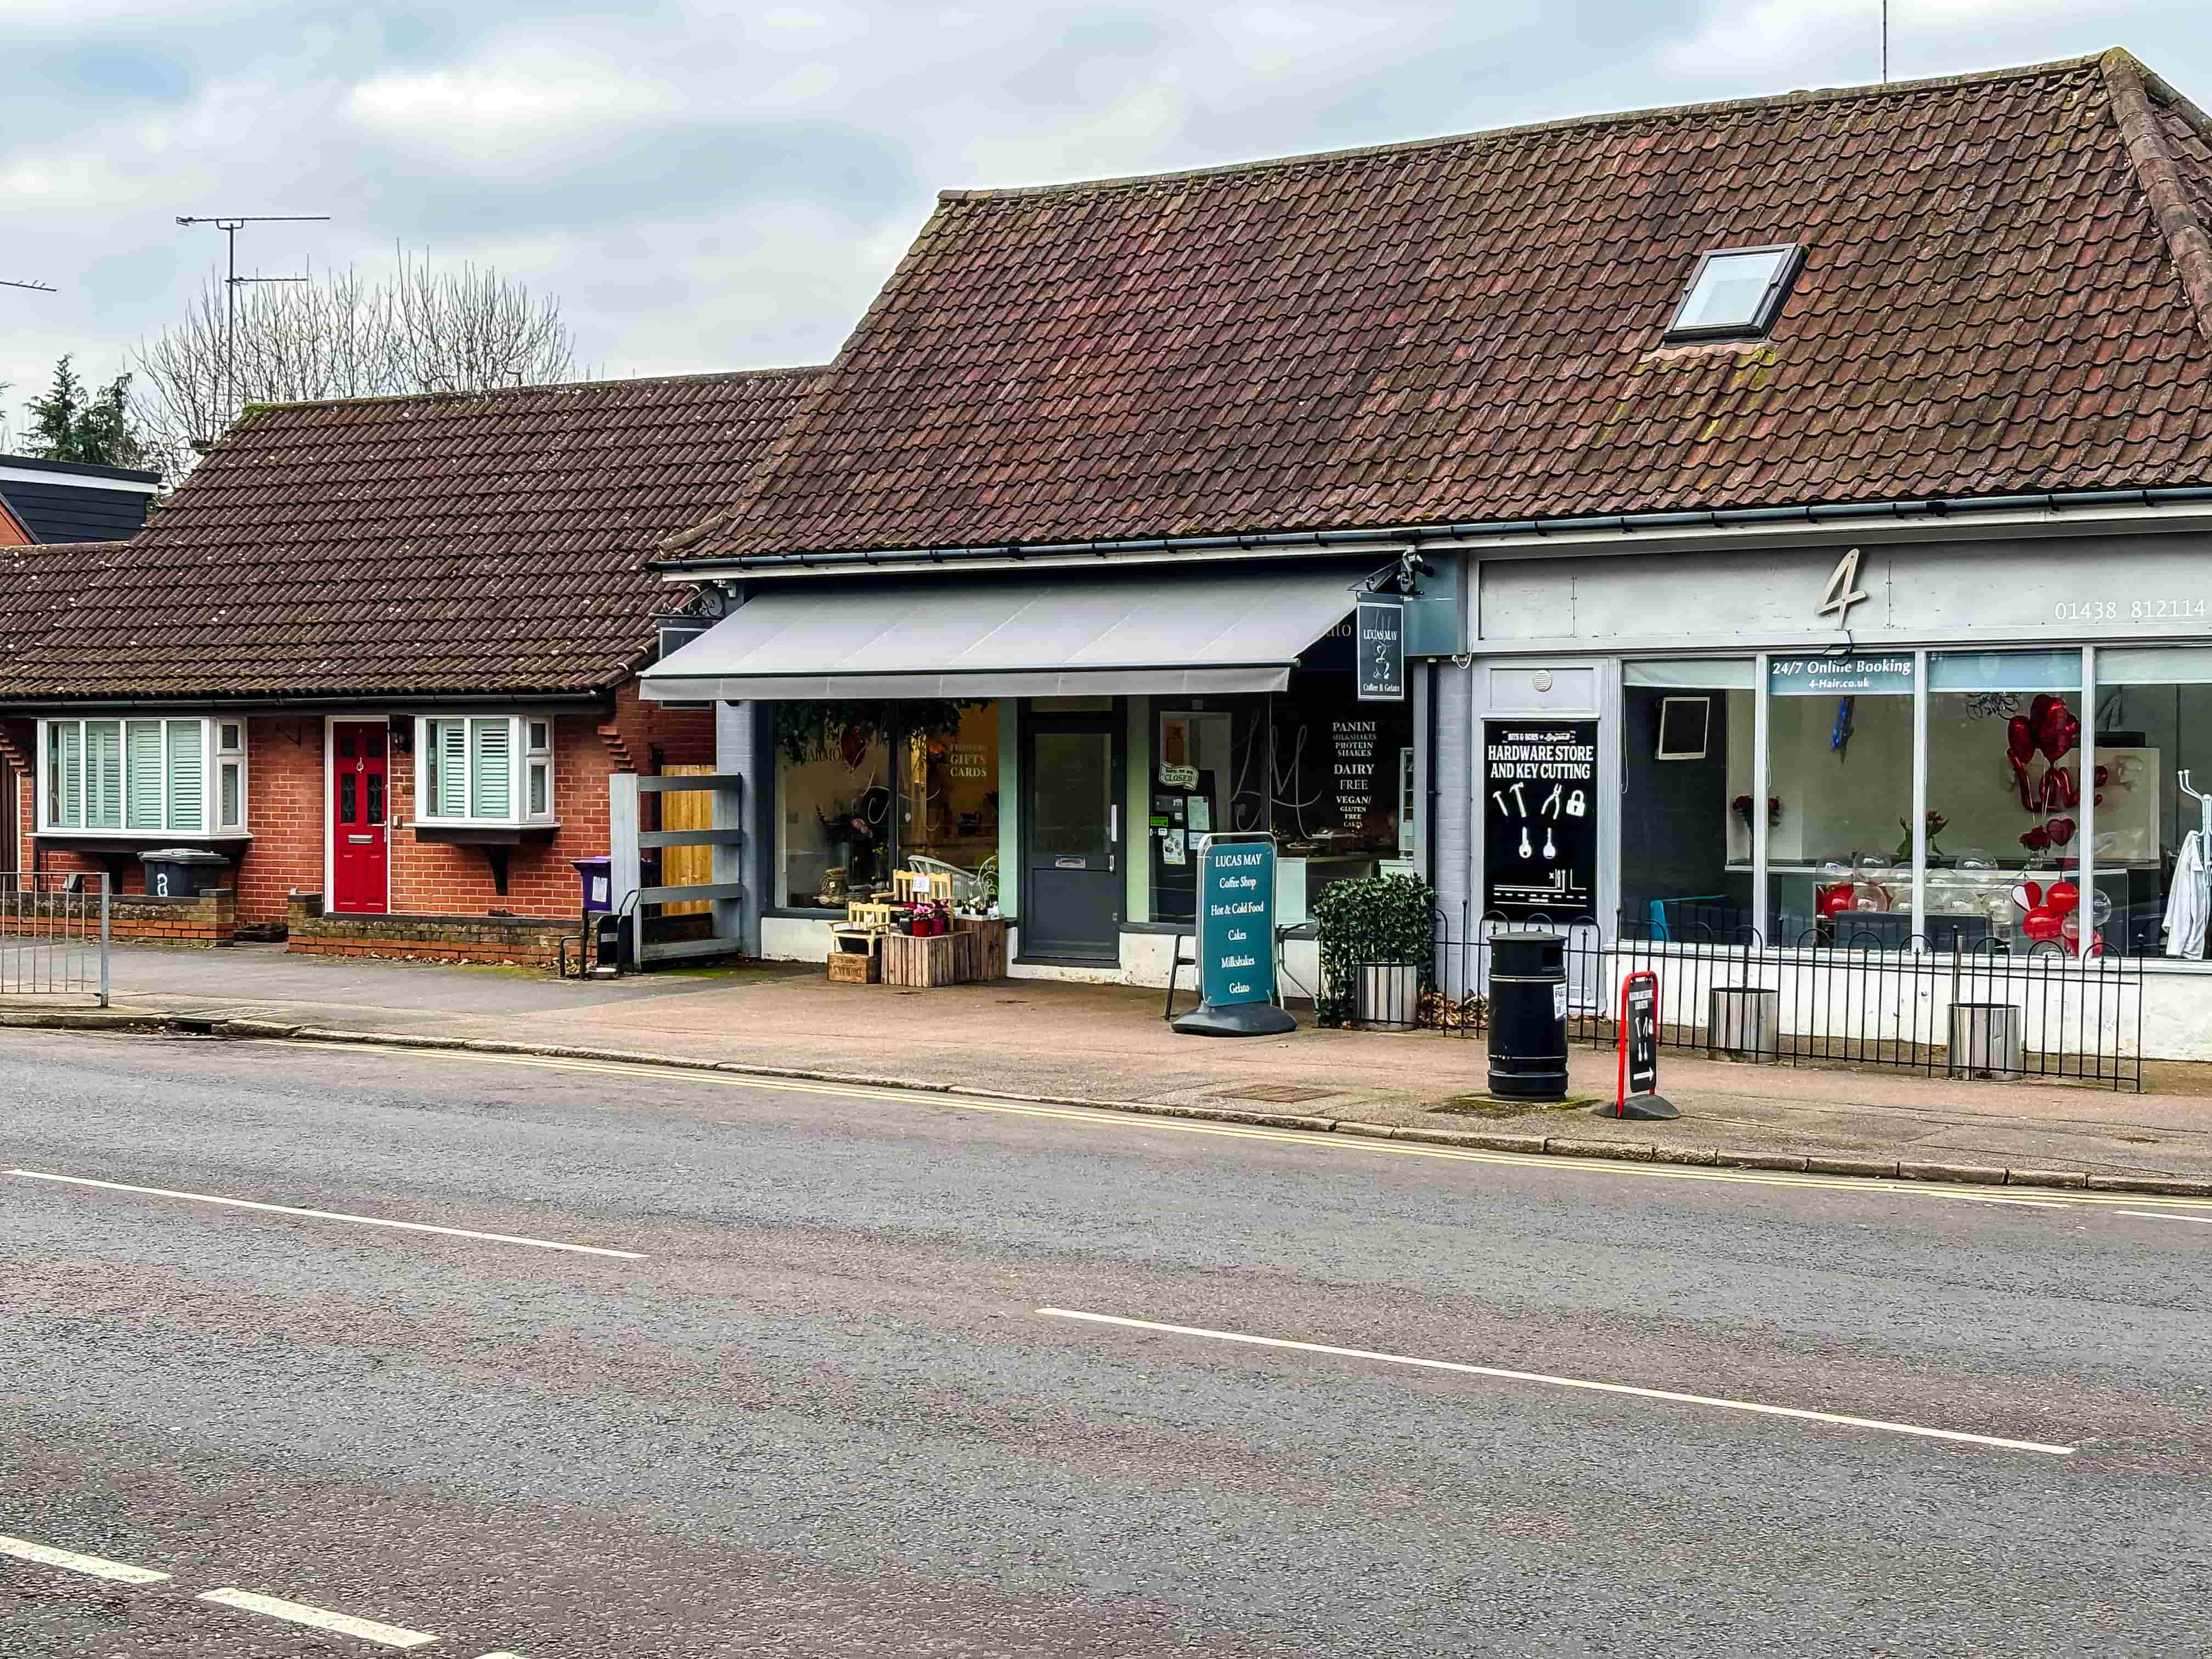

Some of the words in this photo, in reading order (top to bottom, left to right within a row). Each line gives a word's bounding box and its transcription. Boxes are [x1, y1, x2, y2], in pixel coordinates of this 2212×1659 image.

[1816, 548, 1870, 629] 4
[2055, 601, 2117, 620] 01438
[2131, 599, 2206, 618] 812114
[1773, 662, 1803, 676] 24/7
[1807, 661, 1852, 674] Online
[1857, 658, 1911, 675] Booking
[1809, 677, 1870, 688] 4-Hair.co.uk
[1332, 721, 1376, 732] PANINI
[951, 754, 986, 764] GIFTS
[1488, 746, 1554, 761] HARDWARE
[1555, 746, 1594, 761] STORE
[950, 768, 987, 777] CARDS
[1334, 764, 1374, 775] DAIRY
[1491, 763, 1515, 778] AND
[1516, 763, 1538, 778] KEY
[1540, 763, 1590, 779] CUTTING
[1164, 774, 1193, 782] CLOSED
[1340, 780, 1368, 790] FREE
[1215, 854, 1242, 867] LUCAS
[1243, 853, 1262, 865] MAY
[1219, 877, 1239, 889] Coffee
[1240, 876, 1256, 890] Shop
[1211, 904, 1223, 916] Hot
[1224, 904, 1231, 915] &
[1232, 902, 1248, 914] Cold
[1248, 900, 1264, 913] Food
[1228, 928, 1247, 940] Cakes
[1221, 955, 1255, 968] Milkshakes
[1229, 981, 1250, 994] Gelato
